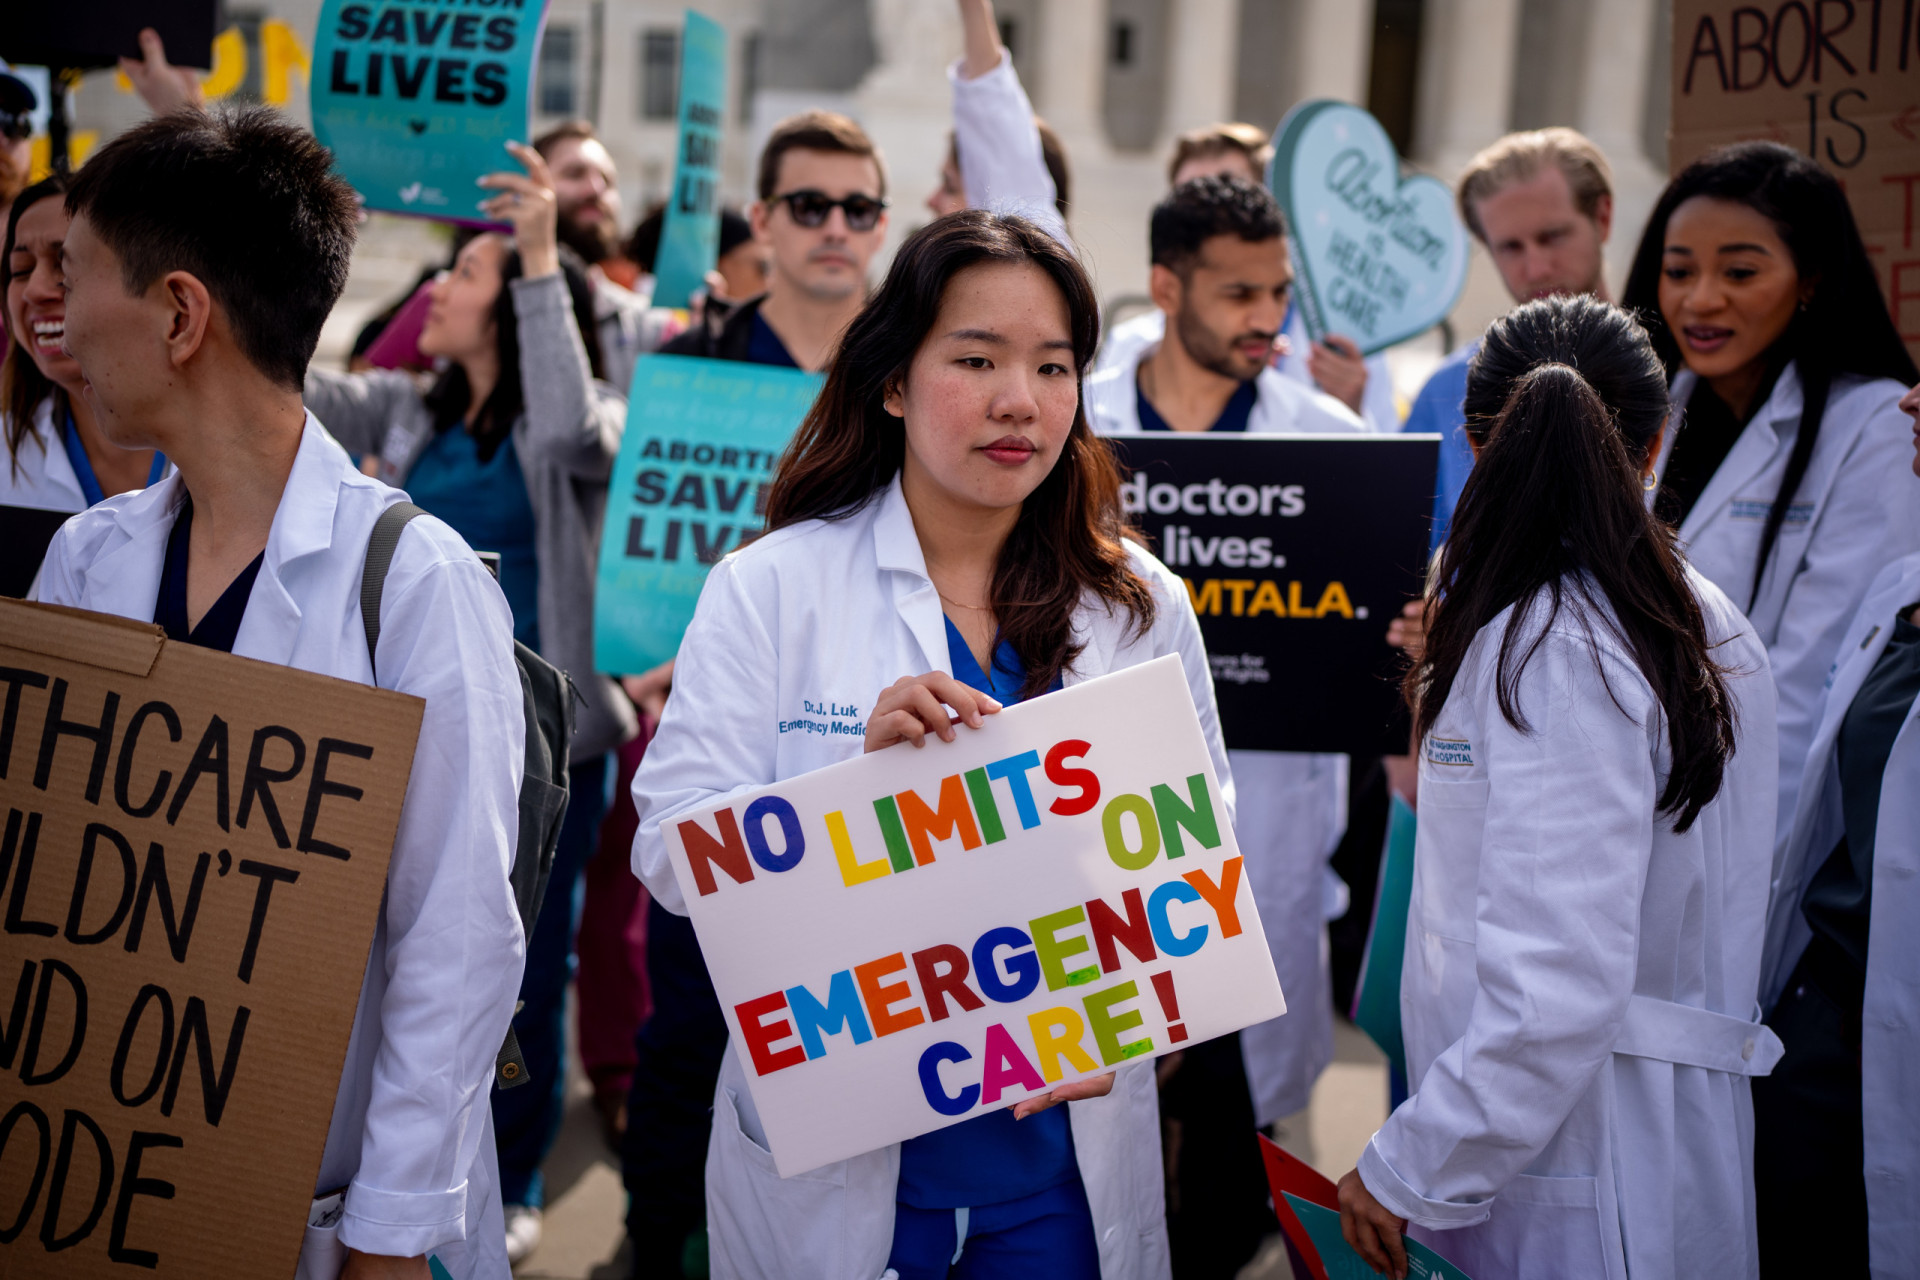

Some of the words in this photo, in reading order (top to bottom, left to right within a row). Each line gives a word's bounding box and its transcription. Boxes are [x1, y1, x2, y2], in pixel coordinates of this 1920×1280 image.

[336, 4, 518, 53] SAVES
[1682, 0, 1920, 96] ABORTI
[329, 50, 509, 106] LIVES
[1804, 87, 1869, 169] IS
[1119, 471, 1305, 517] doctors
[625, 515, 768, 564] LIV
[1163, 525, 1287, 569] lives.
[831, 703, 859, 718] Luk
[1434, 752, 1473, 763] HOSPITAL
[676, 795, 806, 897] NO
[824, 739, 1101, 888] LIMITS
[1101, 772, 1223, 871] ON
[733, 854, 1245, 1078] EMERGENCY
[110, 983, 251, 1127] ON
[917, 970, 1189, 1117] CARE!
